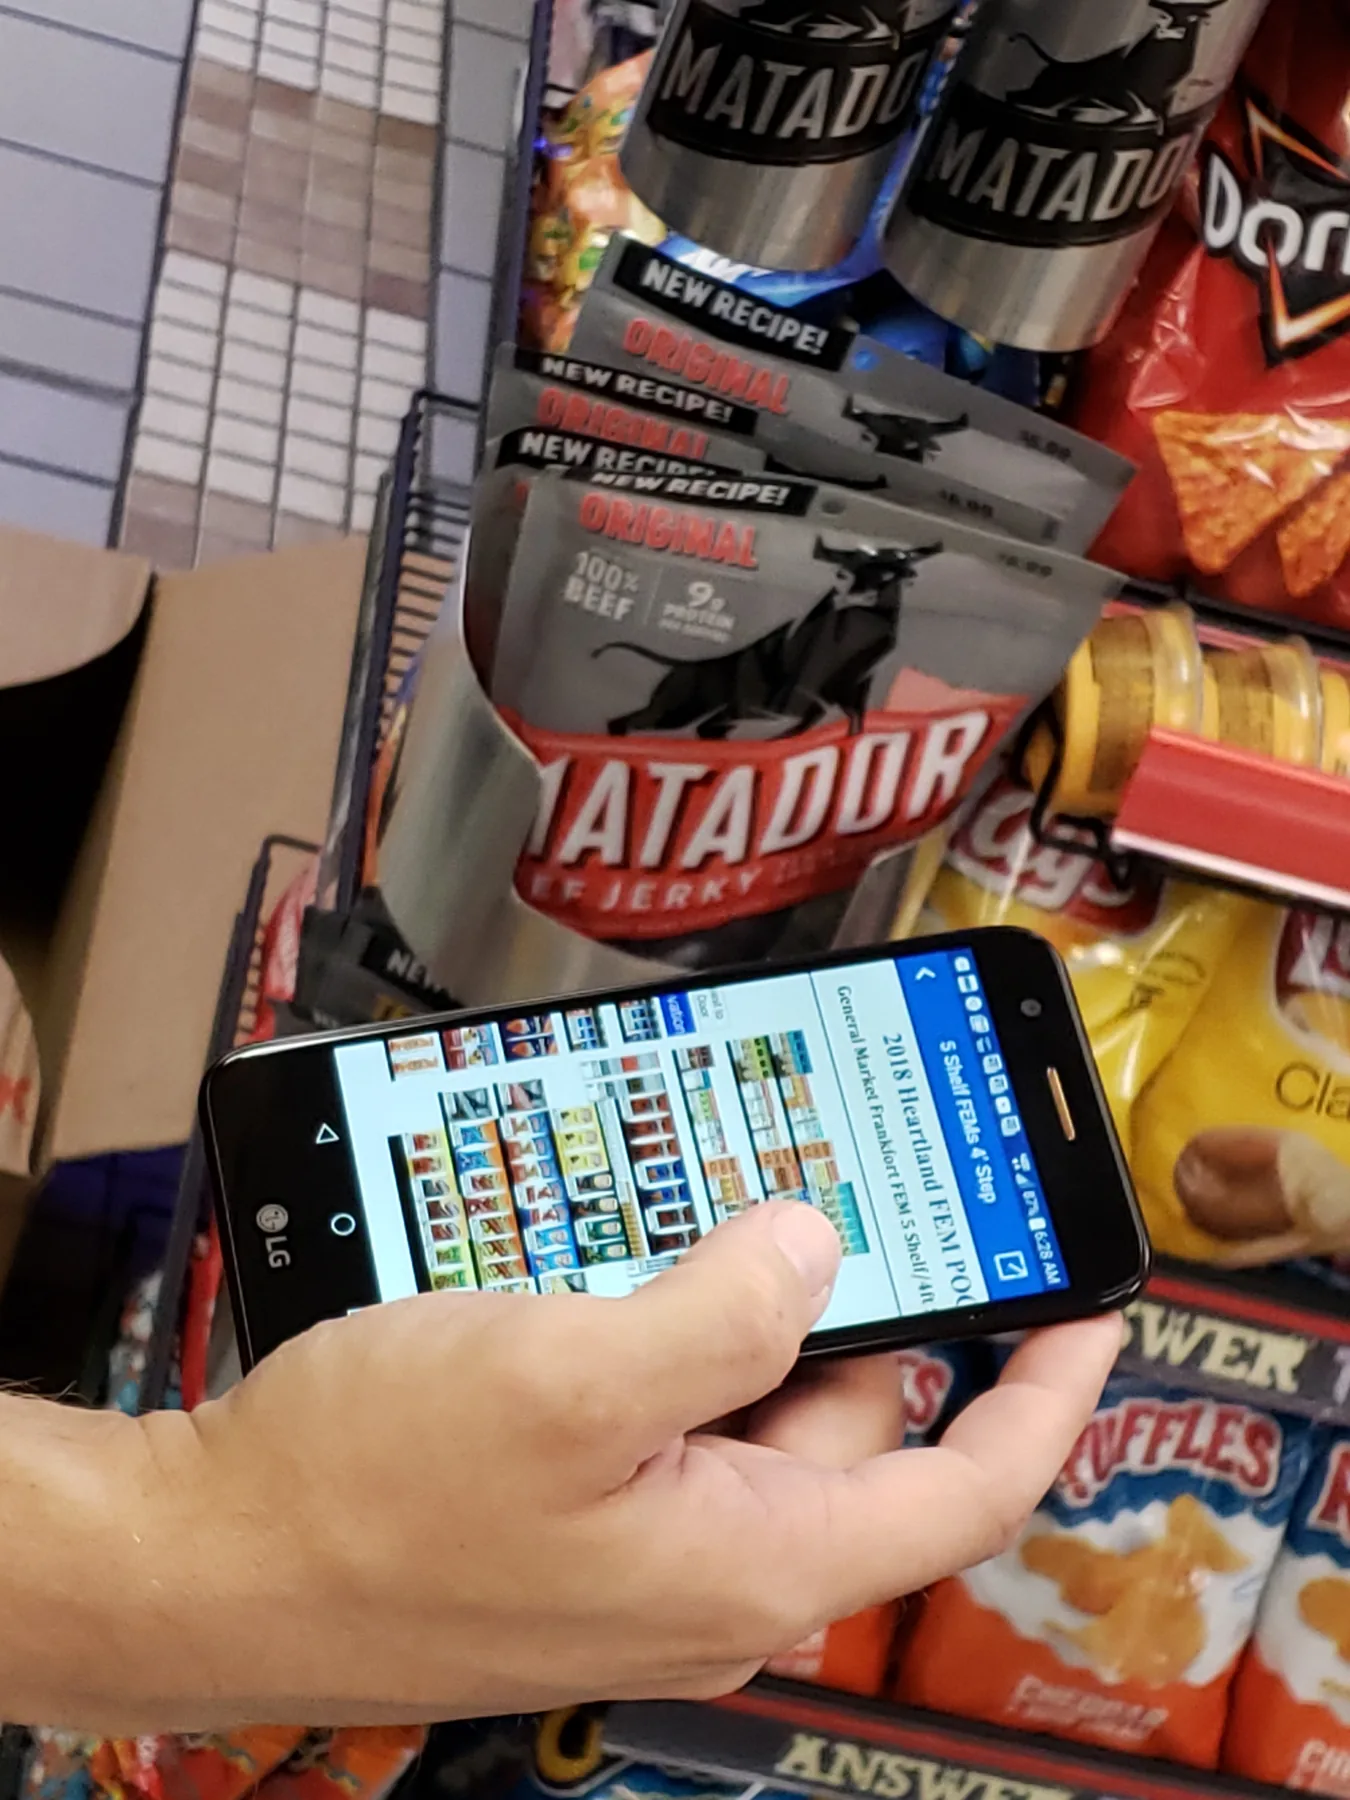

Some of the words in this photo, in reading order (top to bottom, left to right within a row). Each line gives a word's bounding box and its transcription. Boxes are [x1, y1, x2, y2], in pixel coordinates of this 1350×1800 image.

[642, 258, 713, 309] NEW
[709, 293, 829, 356] RECIPE!
[622, 317, 791, 415] ORIGINAL
[541, 355, 611, 388] NEW
[615, 375, 735, 423] RECIPE!
[518, 430, 593, 466] NEW
[590, 471, 665, 491] NEW
[664, 478, 791, 506] RECIPE!
[578, 491, 760, 570] ORIGINAL
[576, 551, 639, 592] 100%
[563, 575, 635, 622] BEEF
[600, 866, 763, 912] JERKY
[943, 1053, 972, 1098] Shelf
[954, 1098, 980, 1143] FEMs
[836, 985, 867, 1044] General
[853, 1045, 879, 1102] Market
[868, 1103, 900, 1184] Frankfort
[889, 1183, 910, 1224] FEM
[904, 1231, 937, 1305] Shelf/4ft
[881, 1032, 913, 1081] 2018
[897, 1084, 944, 1195] Heartland
[928, 1196, 960, 1255] FEM
[973, 1165, 997, 1206] Step
[264, 1235, 292, 1269] LG
[1033, 1230, 1054, 1259] 6:28
[1042, 1261, 1061, 1285] AM
[773, 1733, 1076, 1800] ANSW
